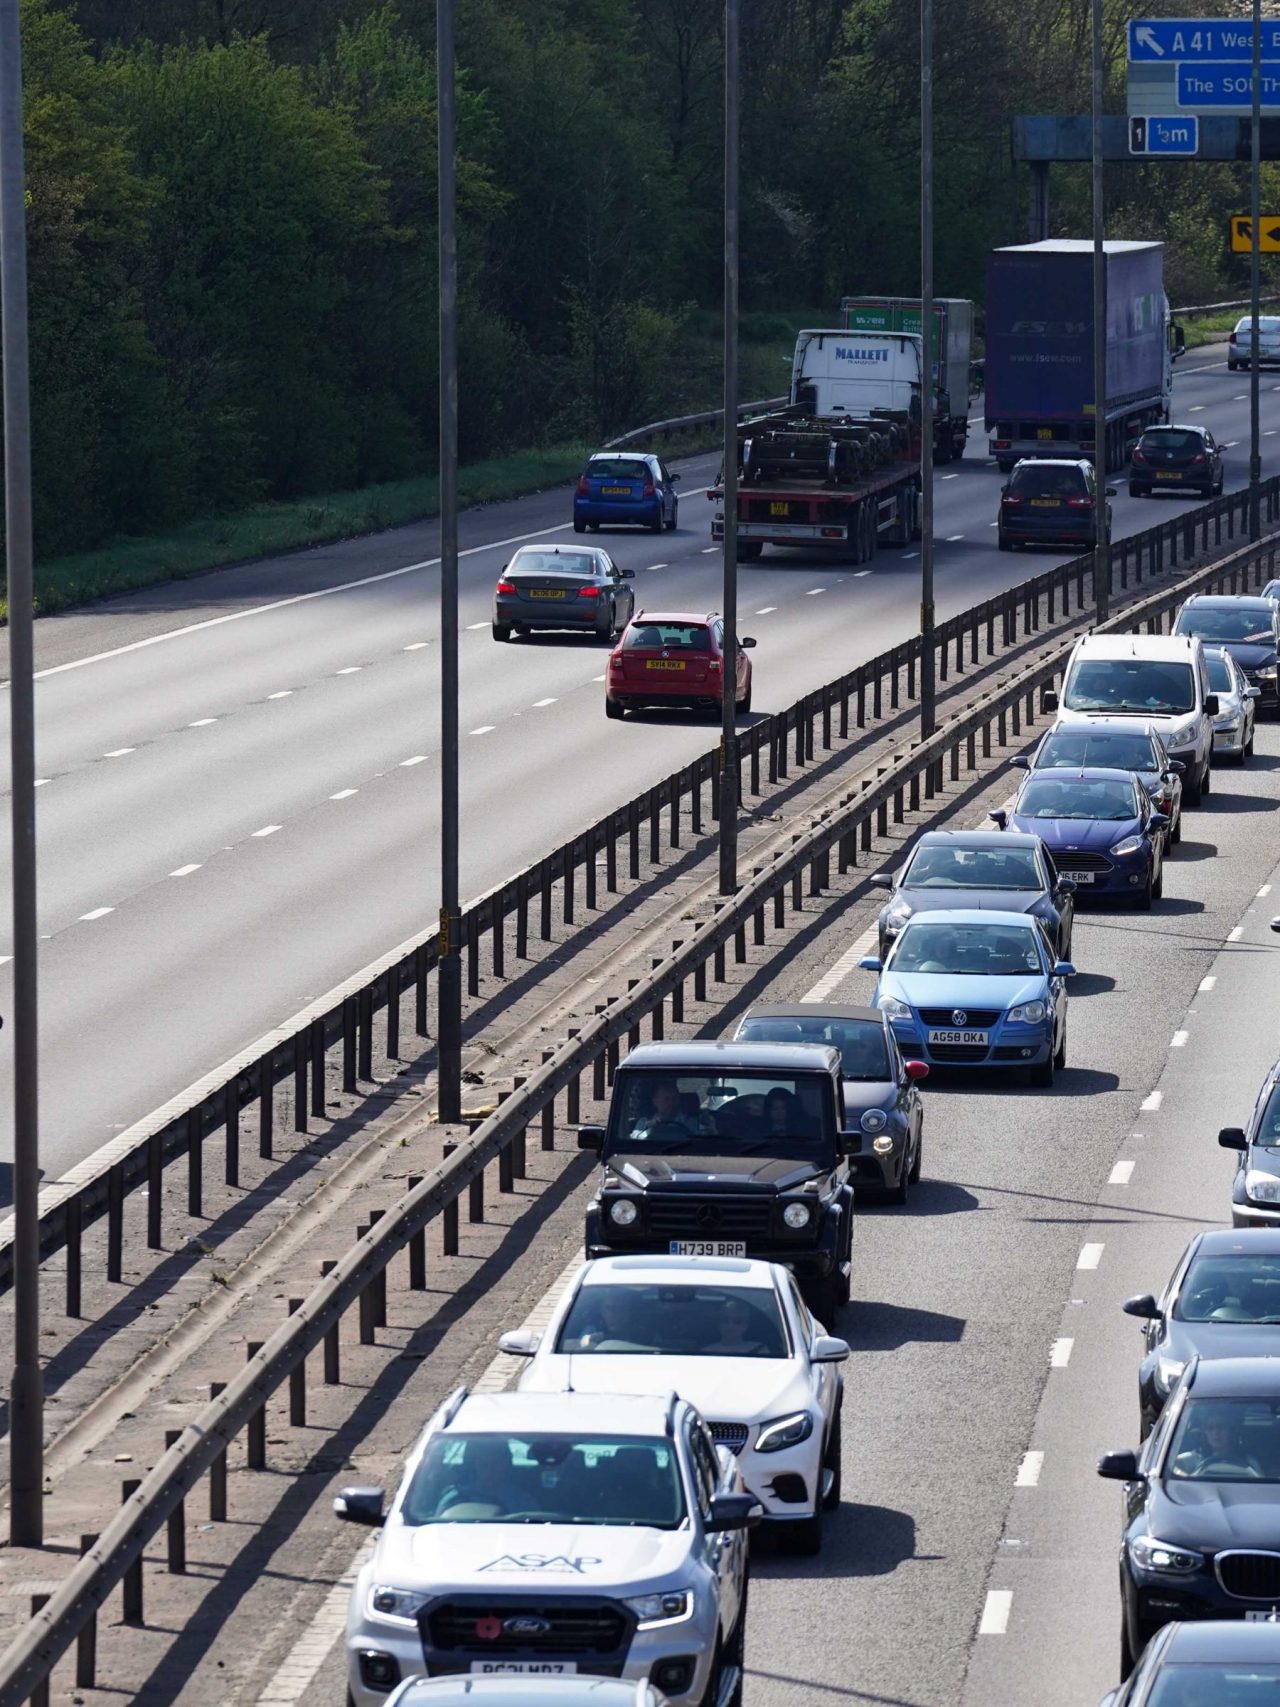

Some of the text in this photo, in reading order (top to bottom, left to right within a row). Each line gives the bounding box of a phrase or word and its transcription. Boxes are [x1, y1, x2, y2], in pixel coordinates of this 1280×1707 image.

[1184, 78, 1214, 92] The
[835, 347, 889, 362] MALLETT
[1072, 872, 1089, 882] ERK
[932, 1031, 984, 1044] AG58 OKA
[680, 1243, 744, 1256] H739 BRP
[477, 1554, 602, 1574] ASAP
